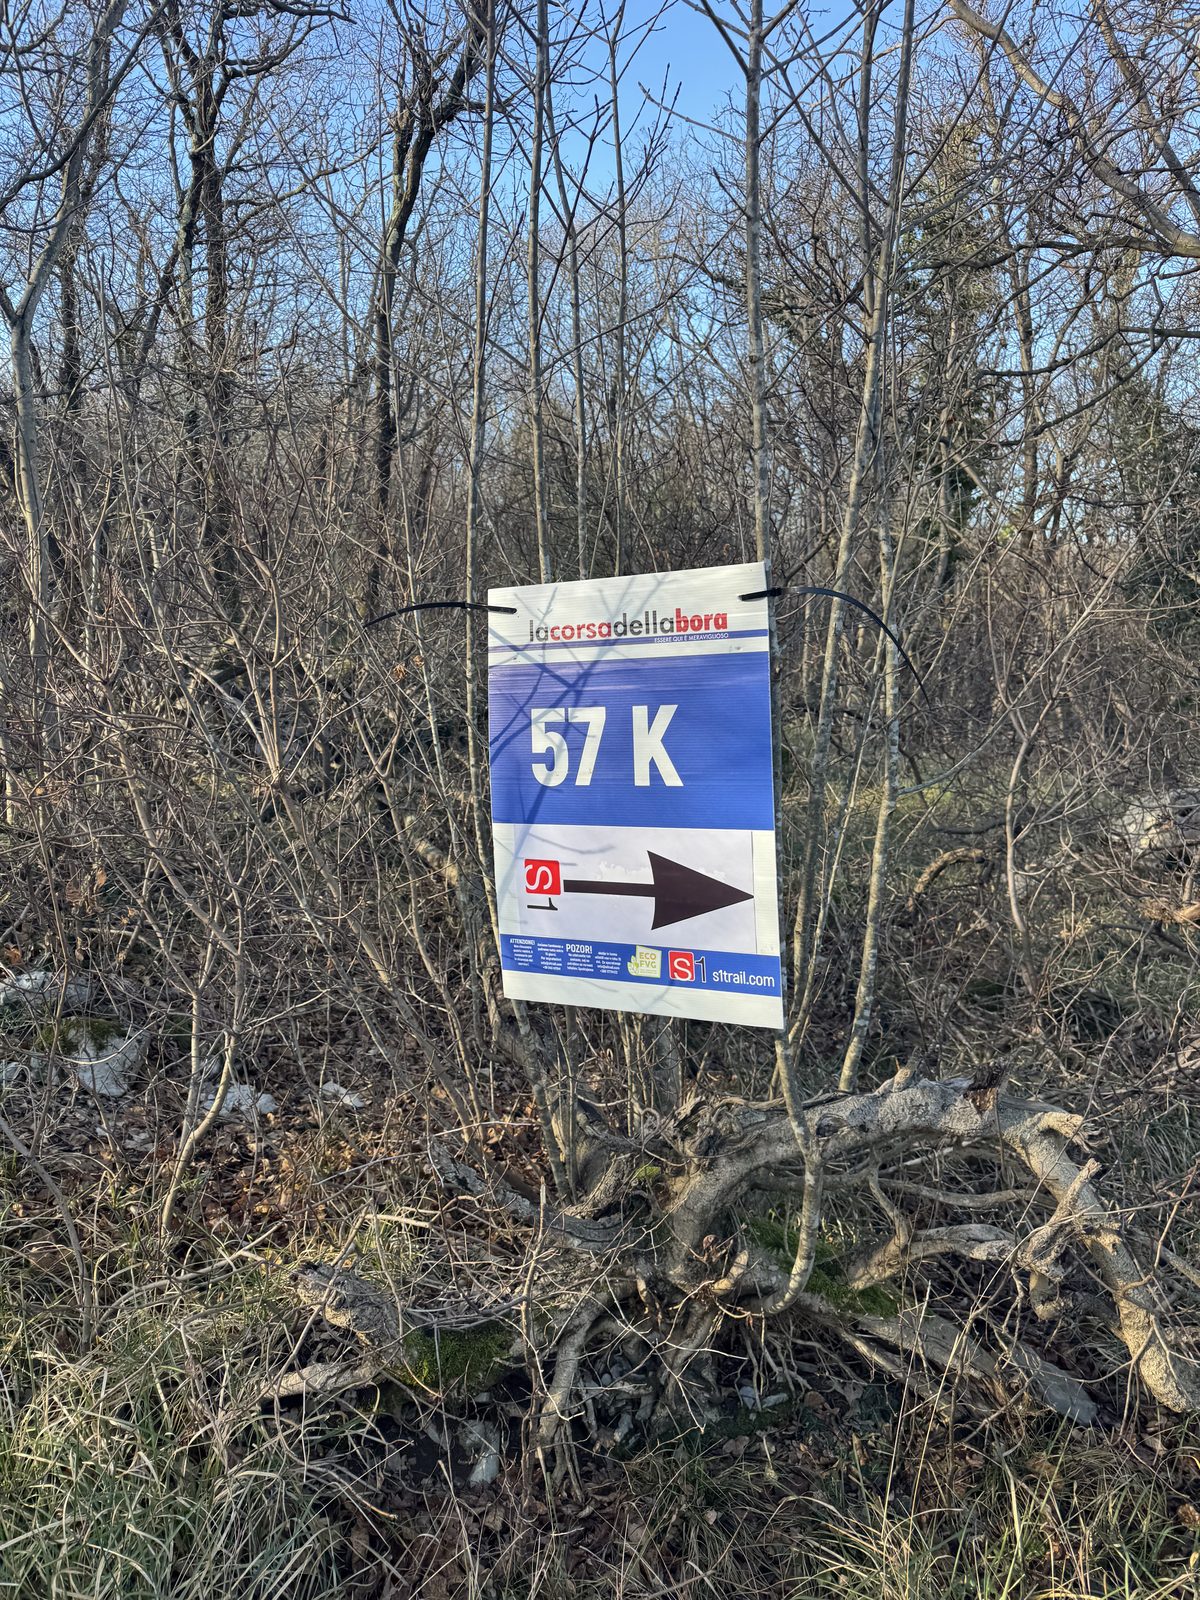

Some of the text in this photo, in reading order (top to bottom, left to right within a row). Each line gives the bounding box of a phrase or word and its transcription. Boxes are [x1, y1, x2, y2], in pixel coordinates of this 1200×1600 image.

[529, 608, 728, 642] lacorsadellabora
[688, 633, 729, 641] MERAVIGLIOSO
[530, 704, 684, 787] 57 K
[566, 943, 592, 954] POZOR!
[639, 952, 656, 960] ECO
[639, 960, 656, 968] FVG
[712, 969, 775, 988] s1trail.com
